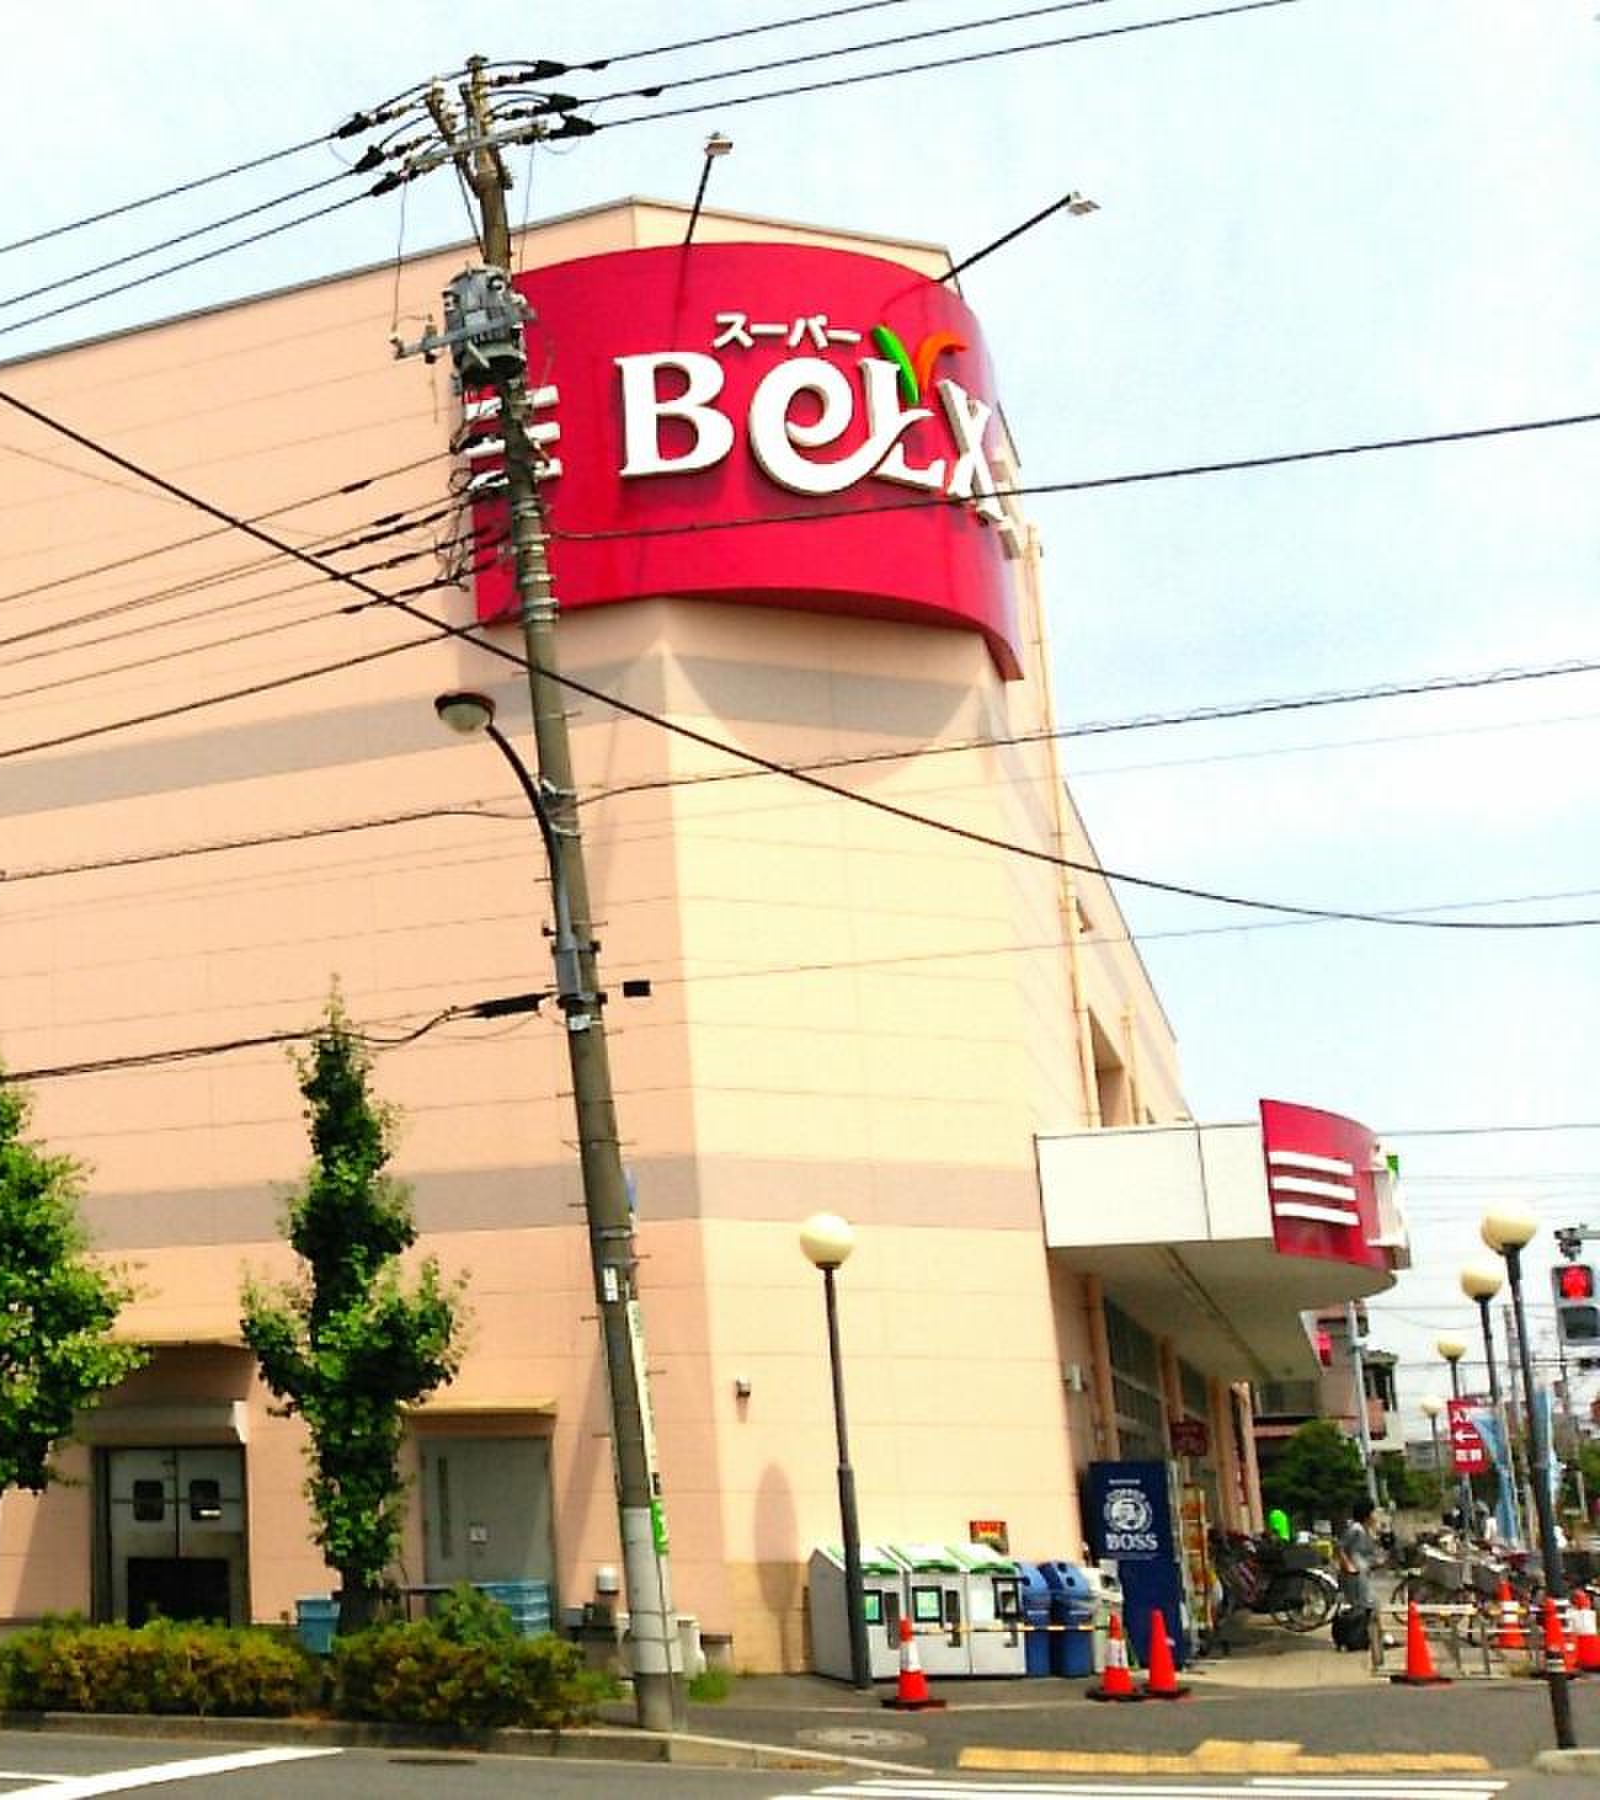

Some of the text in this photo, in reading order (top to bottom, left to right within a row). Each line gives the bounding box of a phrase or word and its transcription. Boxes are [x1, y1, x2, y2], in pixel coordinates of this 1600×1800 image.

[713, 312, 863, 351] スーパー
[1105, 1533, 1158, 1551] BOSS
